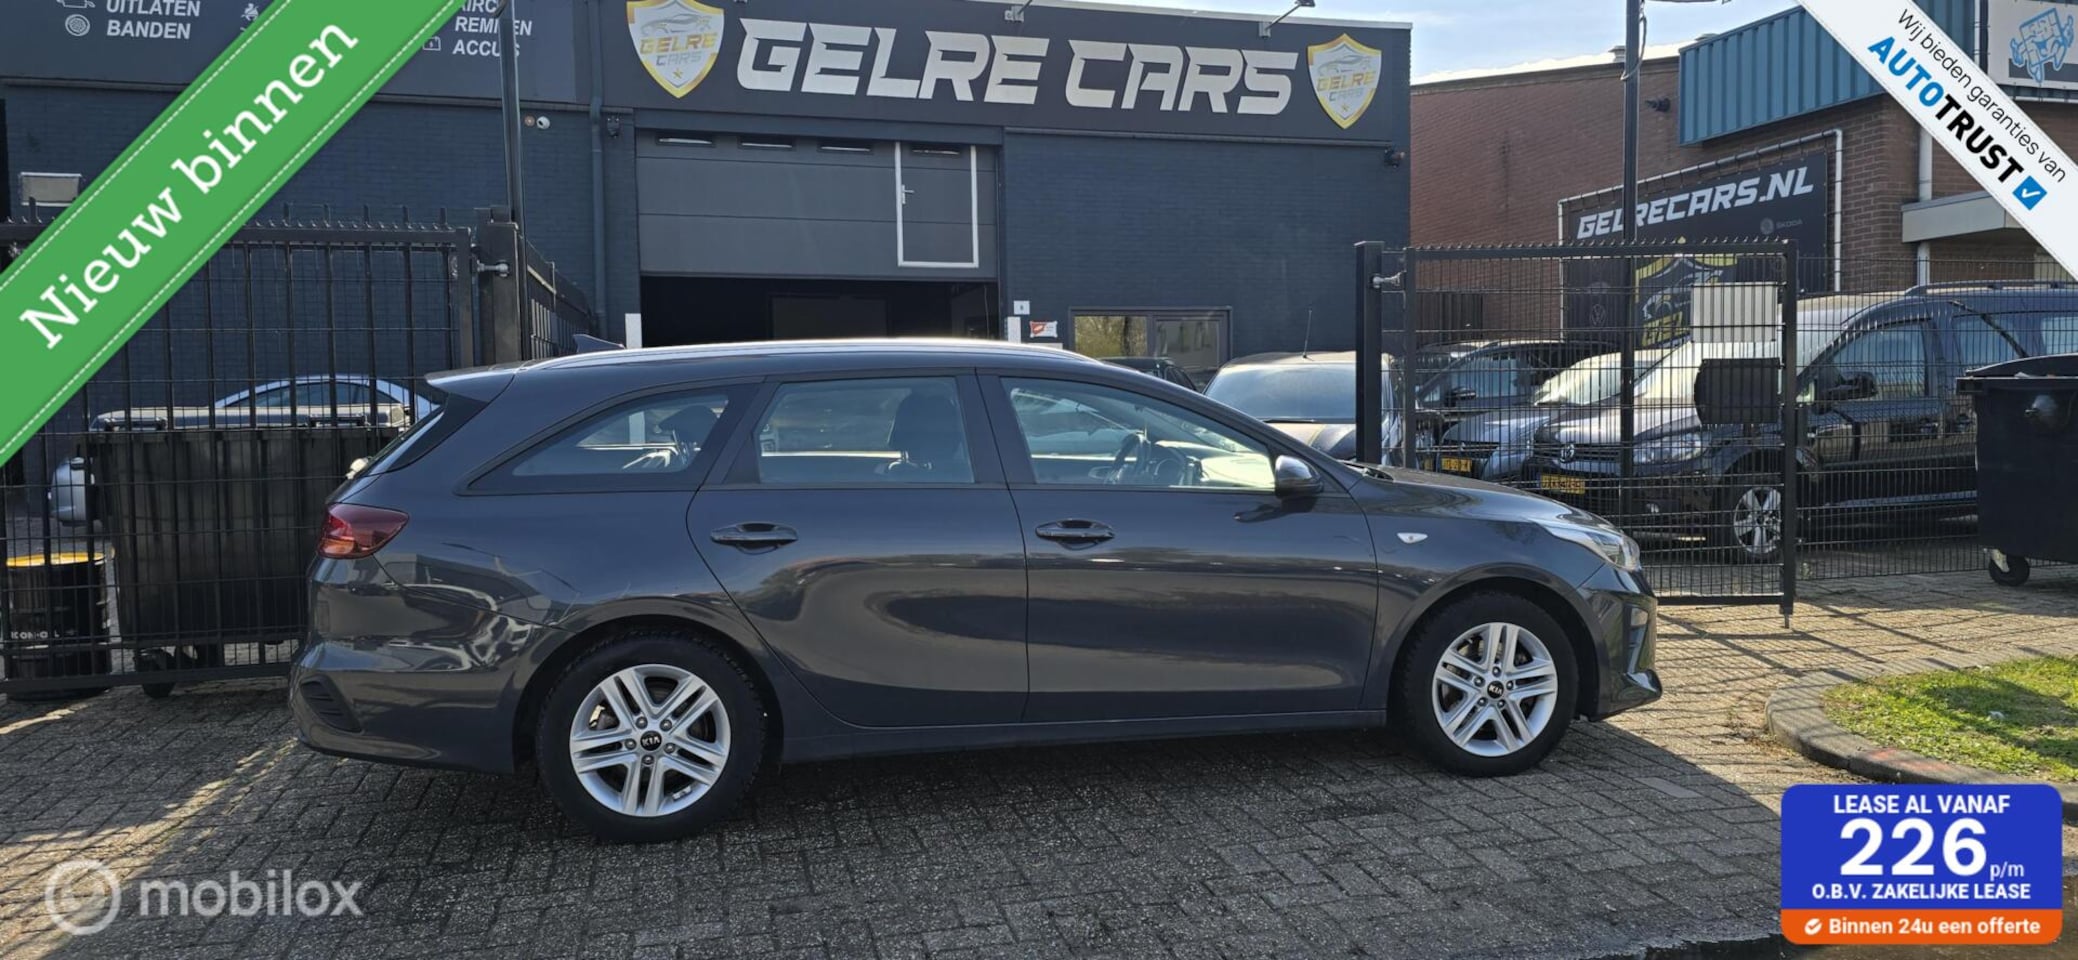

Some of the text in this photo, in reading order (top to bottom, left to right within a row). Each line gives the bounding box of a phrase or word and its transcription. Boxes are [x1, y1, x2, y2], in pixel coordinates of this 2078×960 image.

[105, 0, 200, 17] UITLATEN
[462, 0, 498, 13] IRC
[106, 19, 191, 39] BANDEN
[455, 16, 532, 36] REMEN
[640, 32, 718, 54] GELRE
[656, 51, 703, 66] CARS
[736, 17, 1299, 115] GELRE CARS
[1576, 166, 1814, 239] GELRECARS.NL
